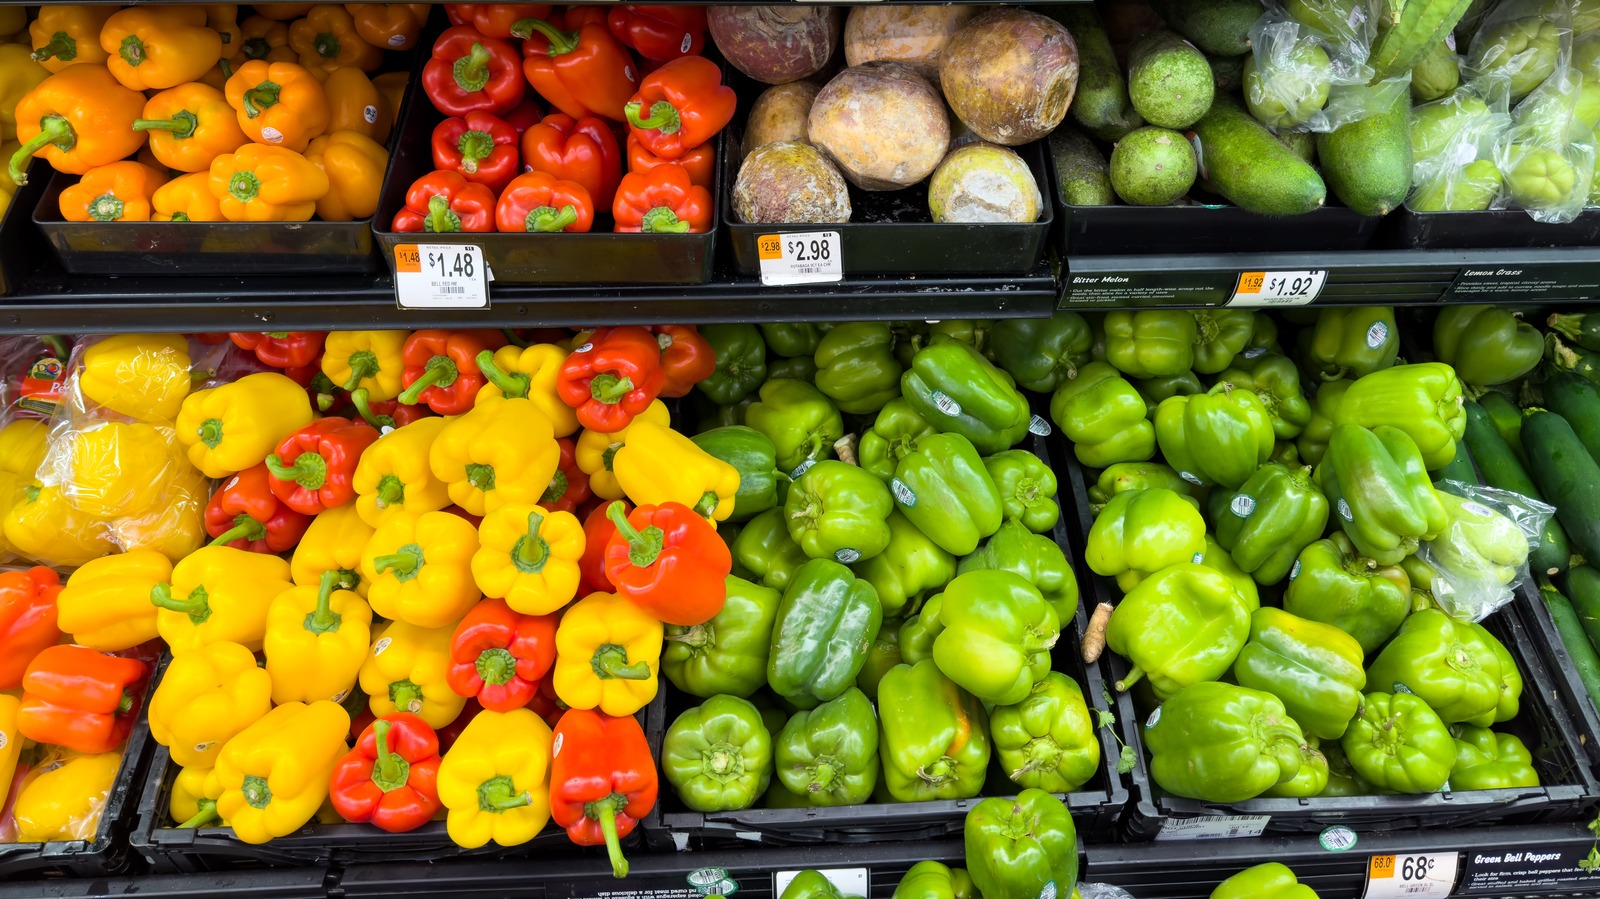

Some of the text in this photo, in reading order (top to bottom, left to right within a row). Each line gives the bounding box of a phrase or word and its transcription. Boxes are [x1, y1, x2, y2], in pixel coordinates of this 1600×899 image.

[761, 242, 780, 251] $2.98
[788, 240, 830, 260] $2.98
[400, 252, 420, 262] $1.48
[428, 252, 474, 277] $1.48
[1244, 278, 1263, 287] $1.92
[1269, 278, 1312, 296] $1.92
[1474, 852, 1561, 864] Green Bell Peppers
[1402, 856, 1435, 881] 68¢
